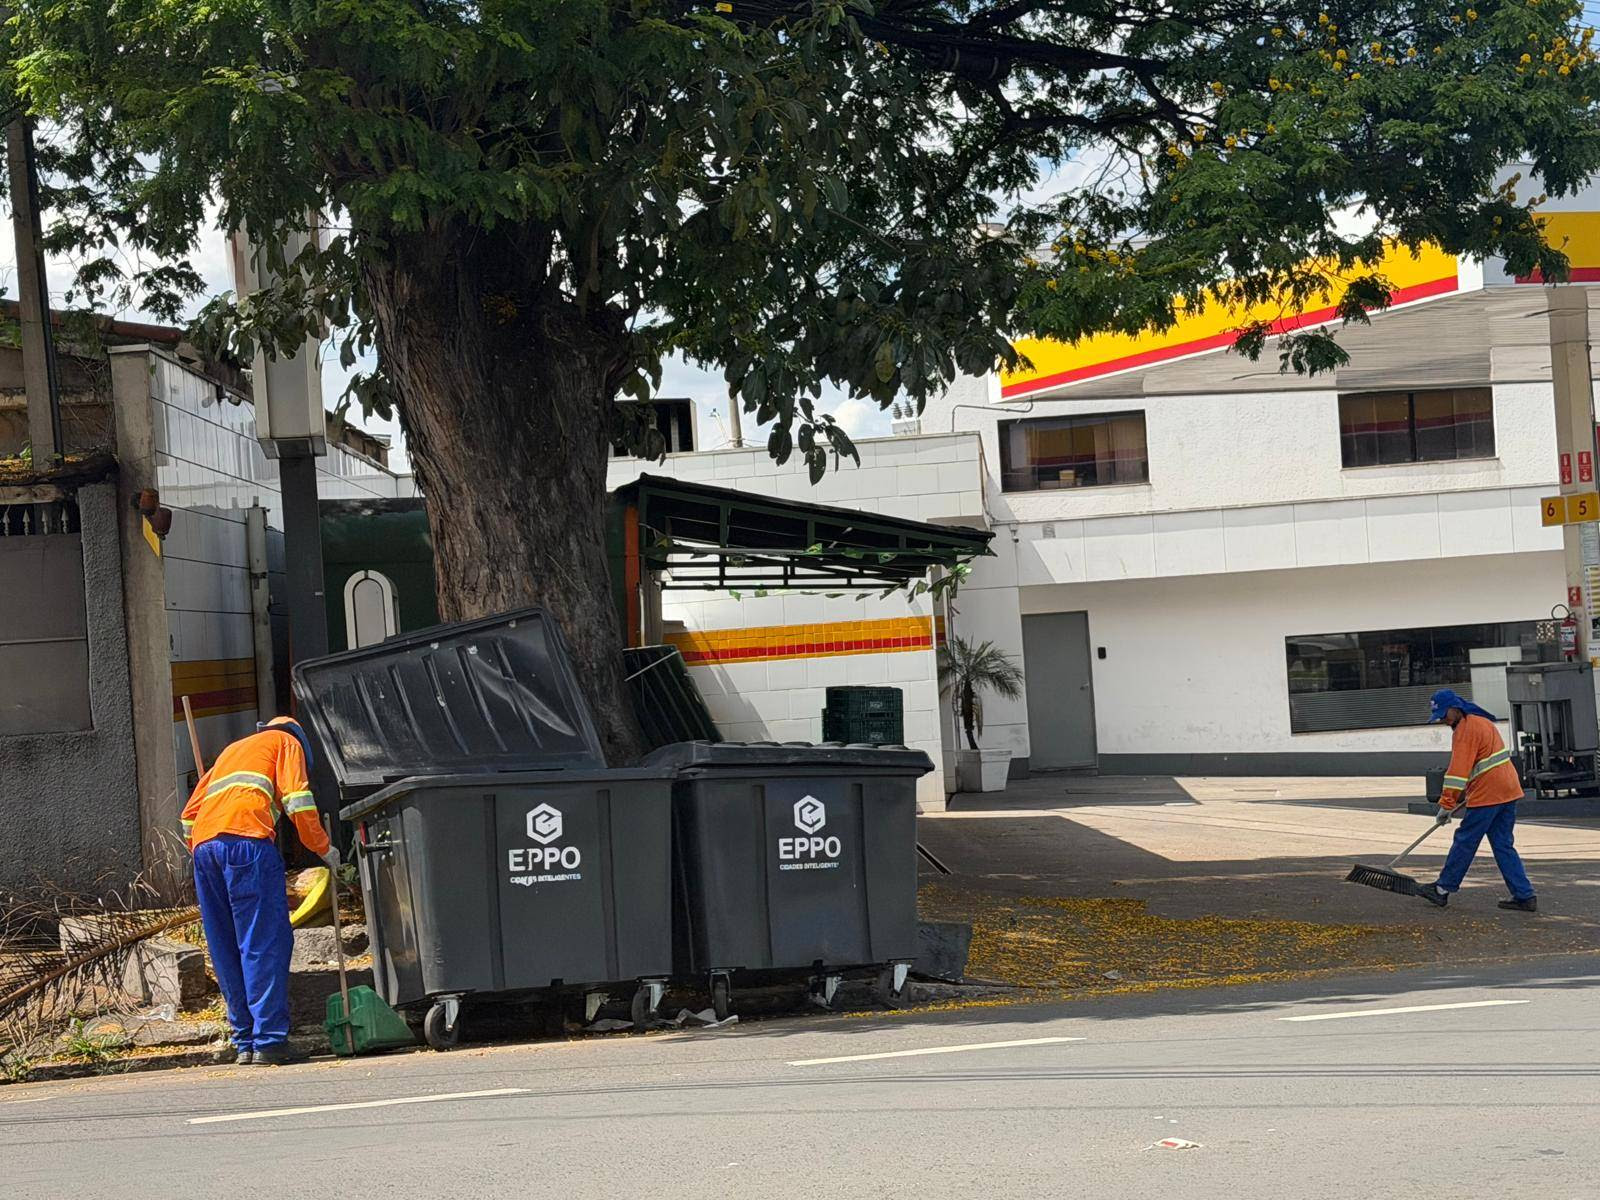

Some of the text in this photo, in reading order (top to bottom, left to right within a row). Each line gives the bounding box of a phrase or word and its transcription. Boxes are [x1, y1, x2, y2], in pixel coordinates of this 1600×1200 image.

[1547, 500, 1587, 517] 6 5
[508, 846, 581, 871] EPPO
[778, 836, 841, 859] EPPO
